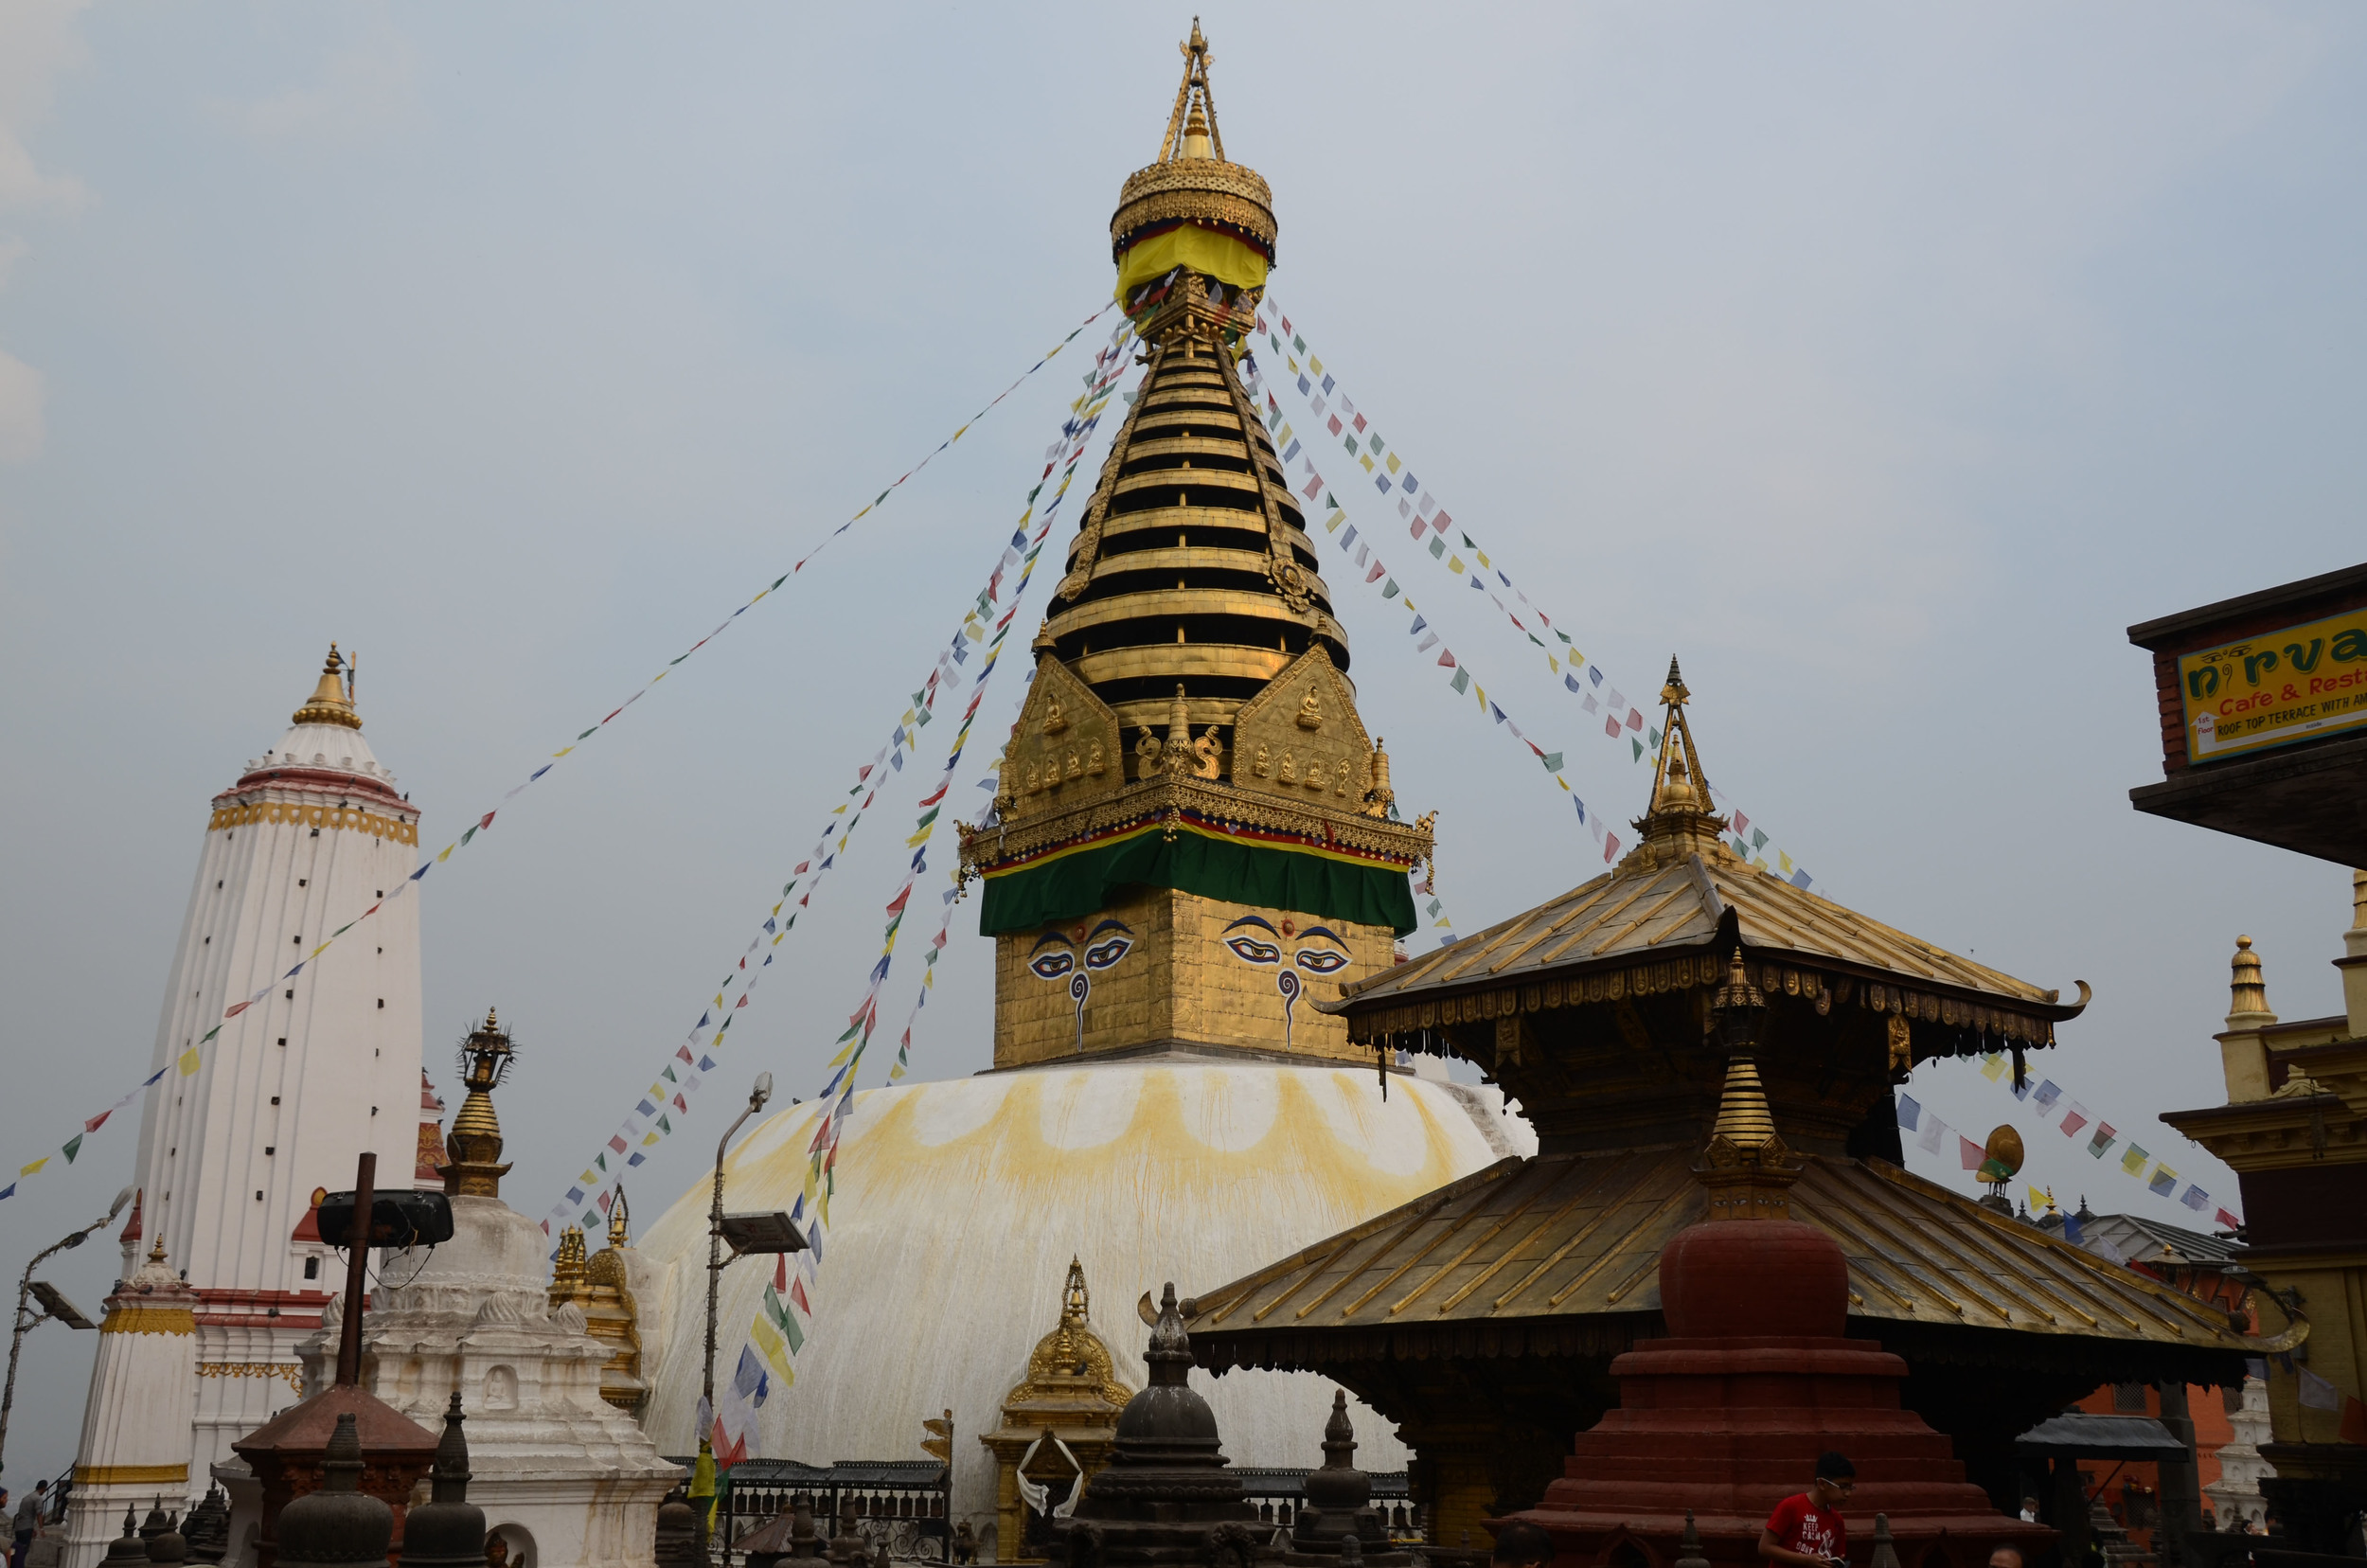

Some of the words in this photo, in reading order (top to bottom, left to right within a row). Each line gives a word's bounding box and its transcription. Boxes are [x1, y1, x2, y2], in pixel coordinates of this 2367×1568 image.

[2219, 690, 2272, 716] Cafe
[2281, 683, 2302, 702] &
[2309, 668, 2367, 695] Rest
[2198, 716, 2210, 724] 1st
[2217, 721, 2242, 736] ROOF
[2246, 716, 2266, 729] TOP
[2268, 704, 2316, 724] TERRACE
[2321, 697, 2350, 713] WITH
[1803, 1522, 1819, 1531] KEEP
[1802, 1531, 1821, 1541] CALM
